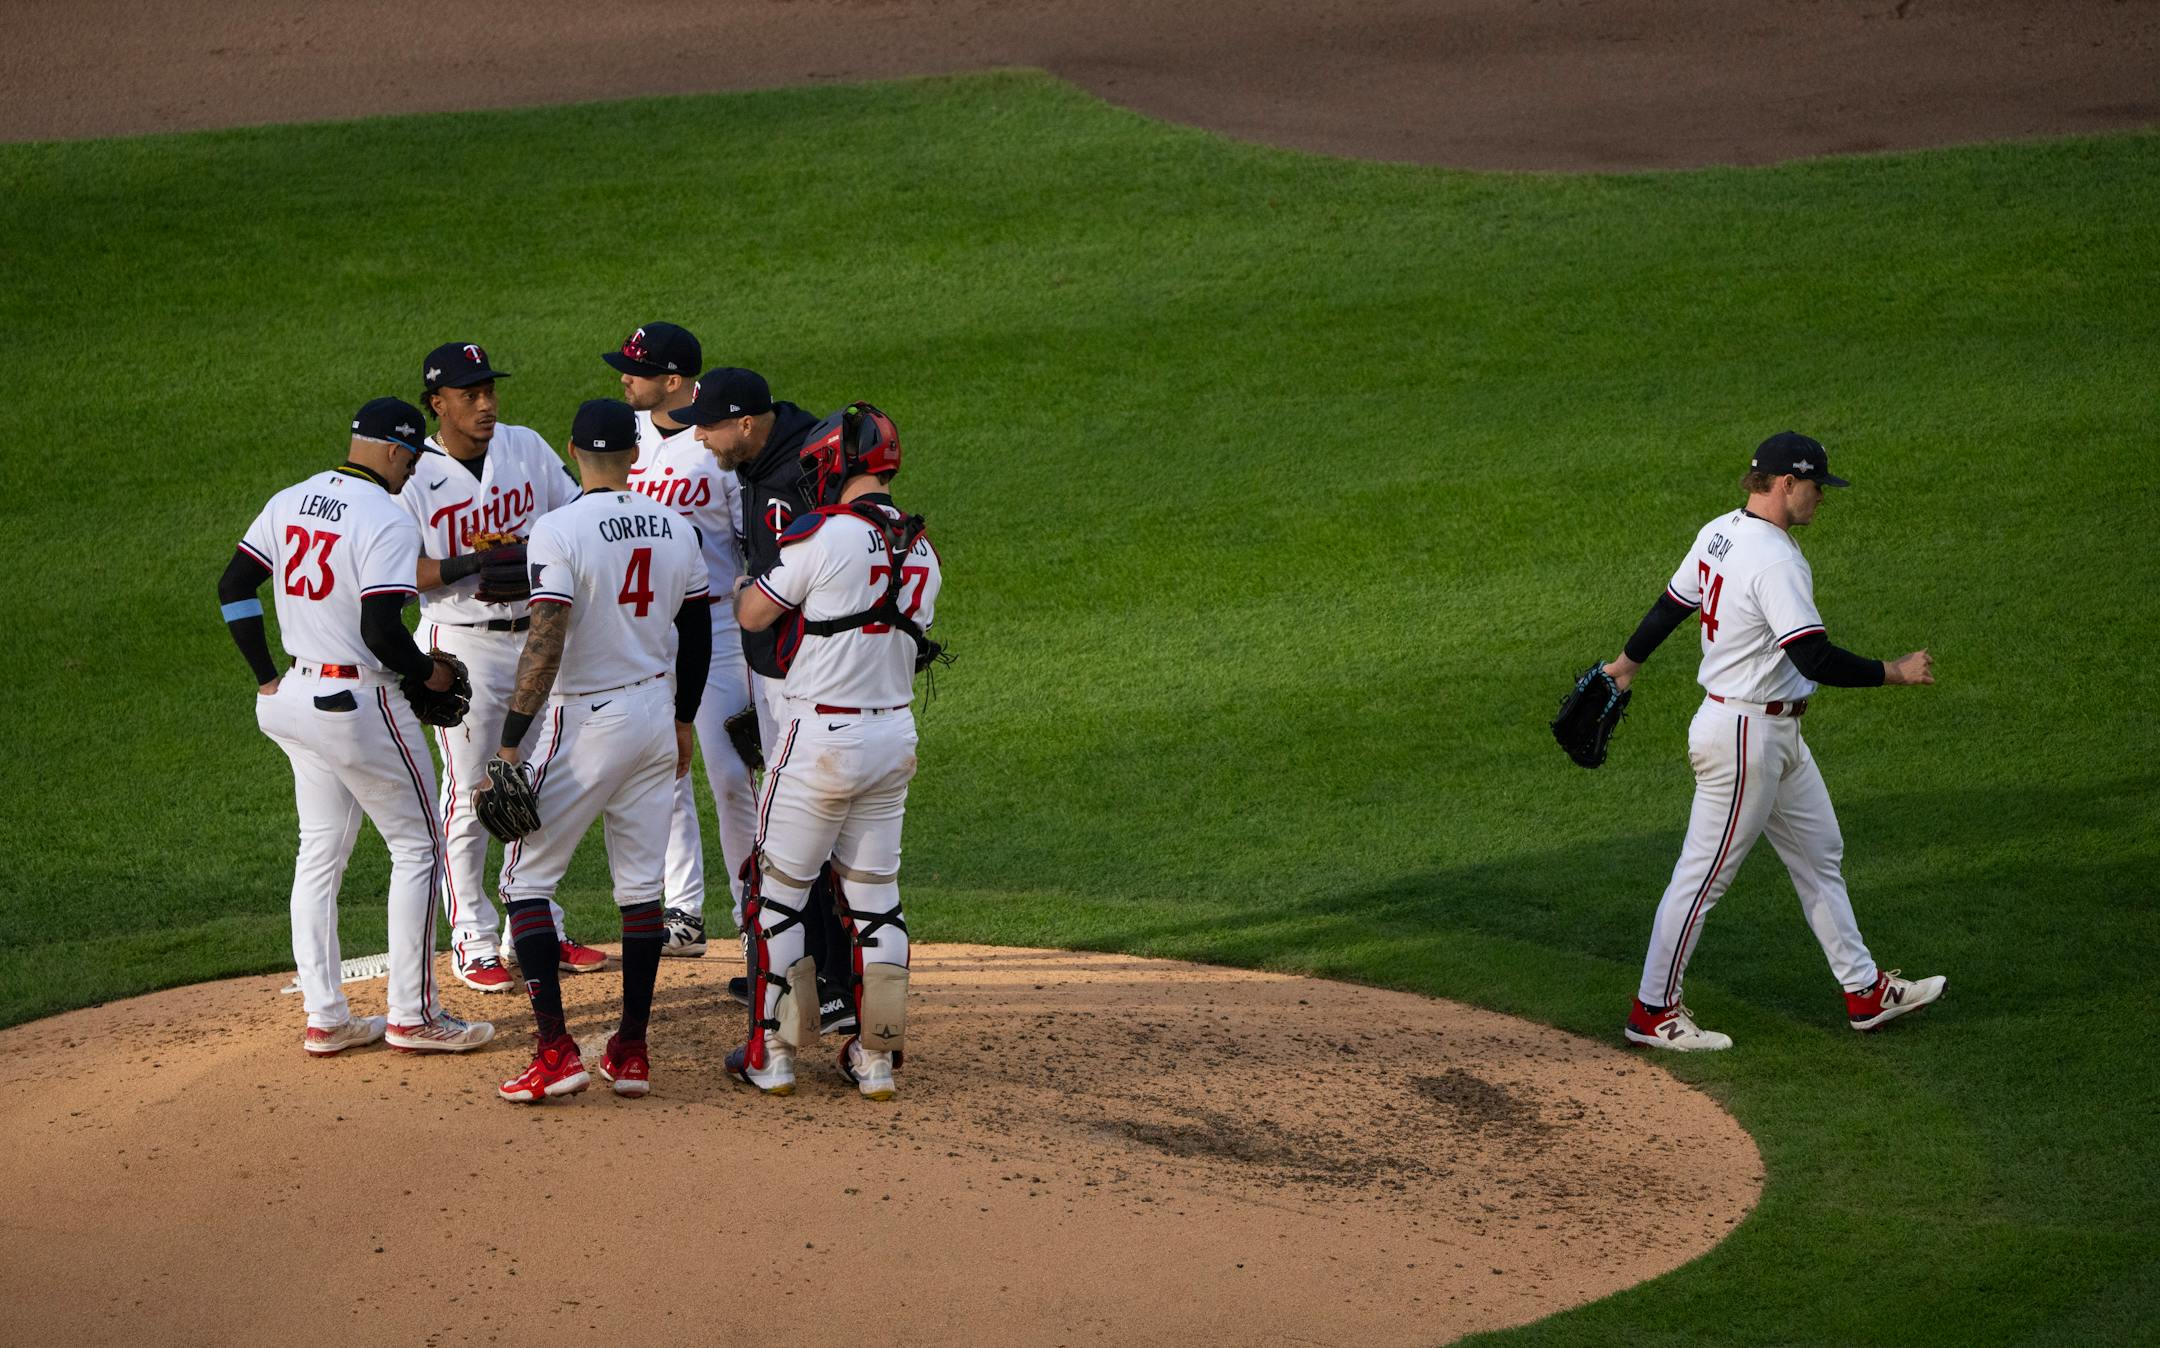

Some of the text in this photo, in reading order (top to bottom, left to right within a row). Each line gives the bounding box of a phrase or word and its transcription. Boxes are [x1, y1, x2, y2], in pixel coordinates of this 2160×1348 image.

[299, 494, 348, 522] LEWIS
[599, 515, 673, 543] CORREA
[1707, 532, 1734, 562] GRAY
[284, 525, 342, 601] 23
[618, 547, 654, 617] 4
